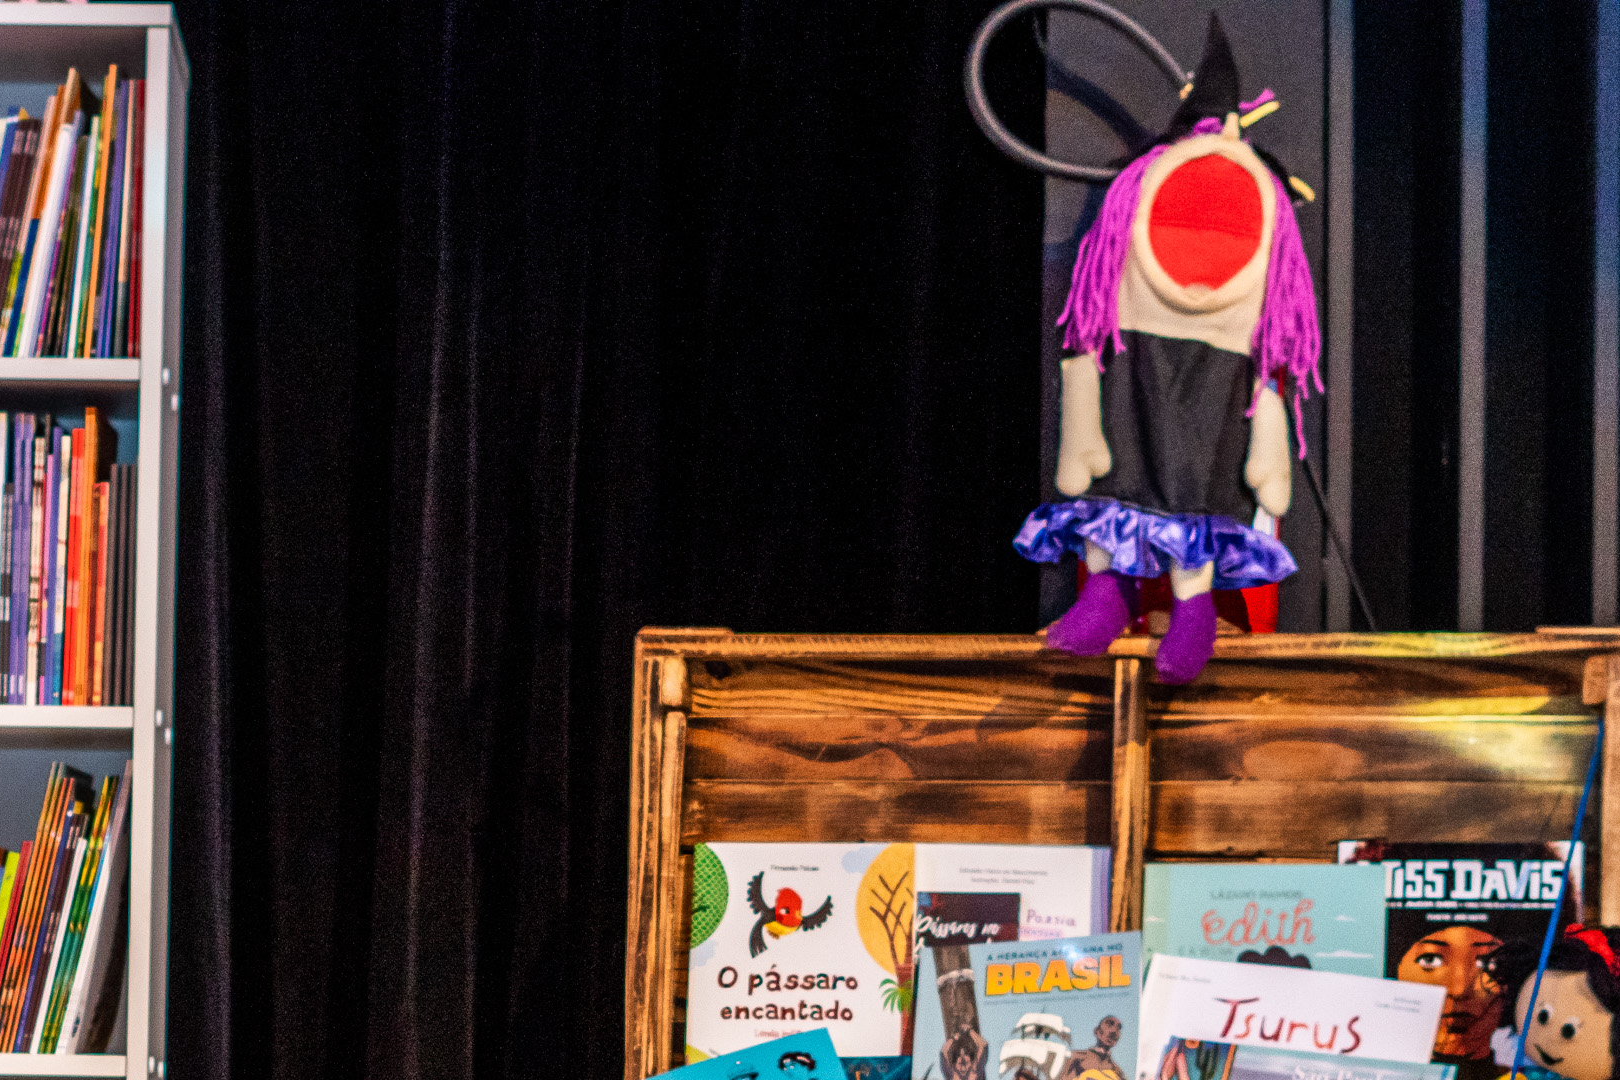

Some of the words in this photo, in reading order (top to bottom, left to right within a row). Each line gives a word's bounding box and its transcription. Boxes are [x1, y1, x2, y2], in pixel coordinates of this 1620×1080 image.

[1201, 898, 1316, 947] edith
[717, 965, 738, 989] O
[748, 963, 859, 996] pássaro
[985, 954, 1131, 996] BRASIL
[720, 999, 854, 1021] encantado
[1214, 996, 1363, 1055] Tsurus
